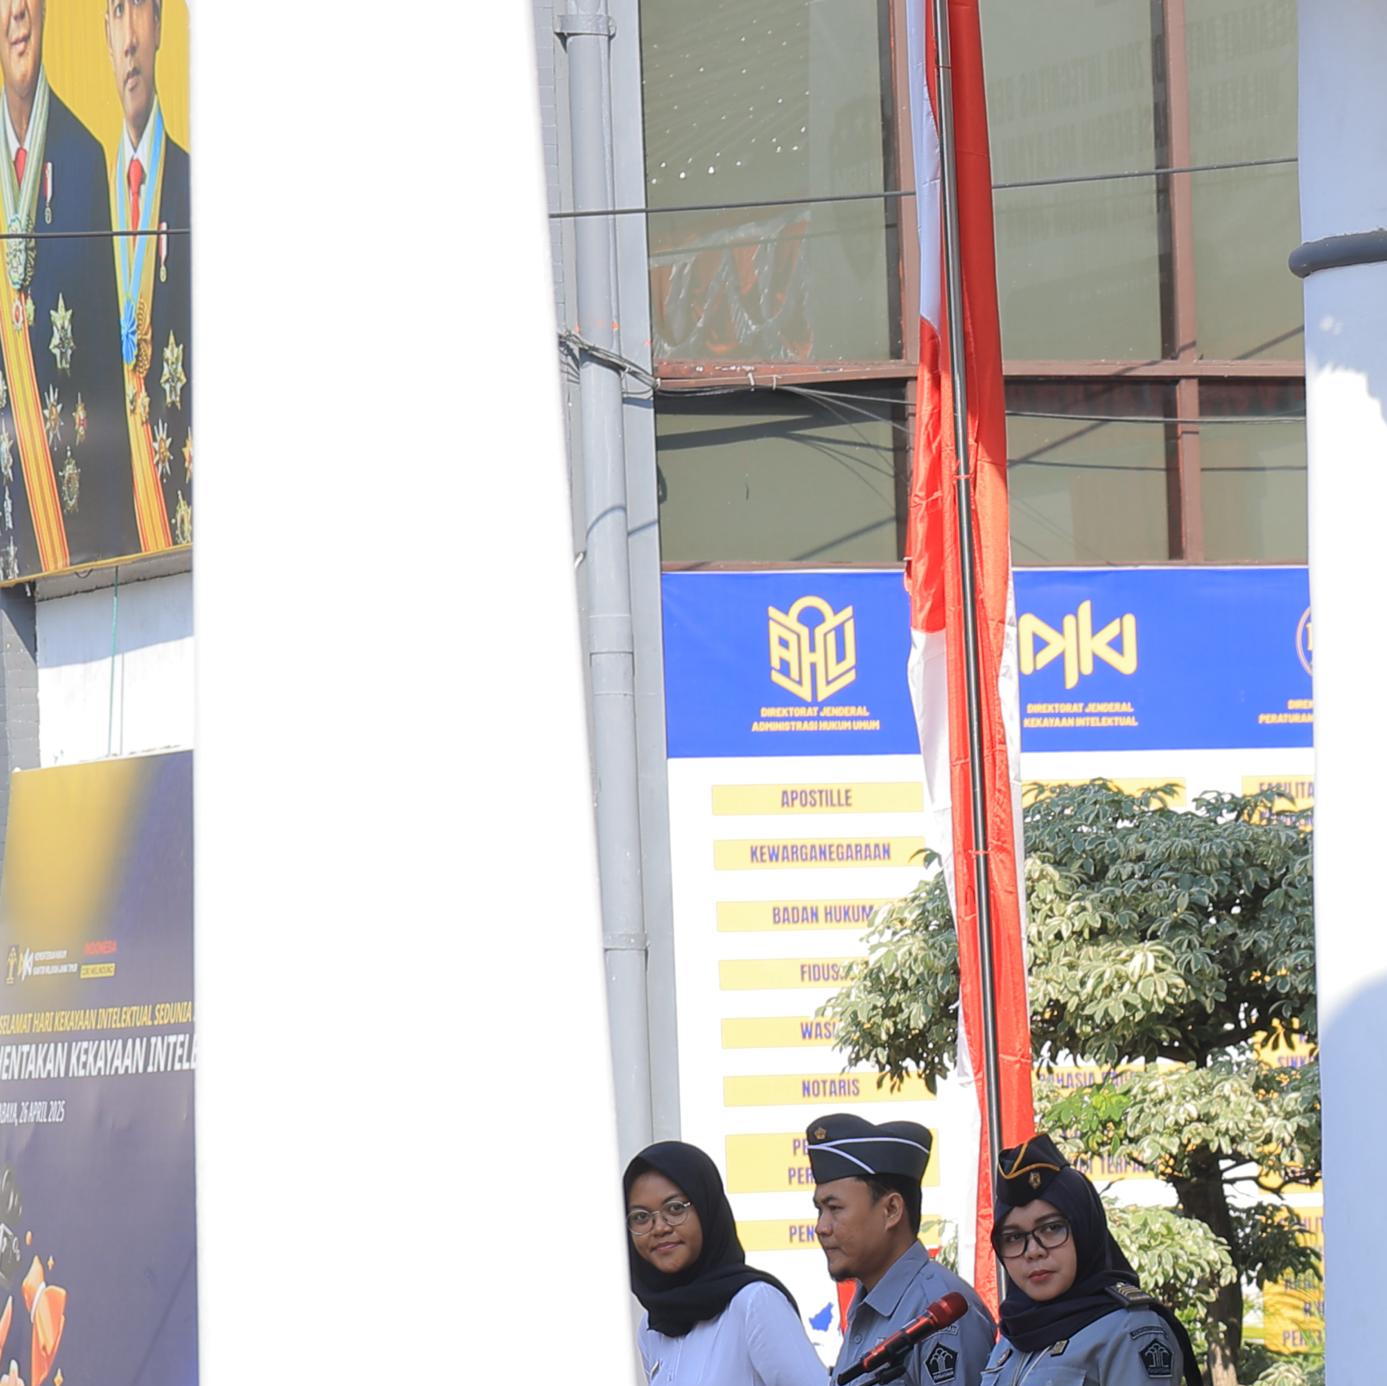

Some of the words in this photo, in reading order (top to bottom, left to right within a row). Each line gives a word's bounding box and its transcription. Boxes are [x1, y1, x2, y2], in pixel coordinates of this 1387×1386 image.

[760, 707, 819, 718] DIREKTORAT
[820, 705, 870, 717] JENDERAL
[1026, 702, 1085, 714] DIREKTORAT
[1085, 701, 1135, 713] JENDERAL
[819, 720, 852, 731] HUKUM
[781, 789, 852, 808] APOSTILLE
[750, 843, 891, 864] KEWARGANEGARAAN
[772, 906, 819, 925] BADAN
[824, 905, 874, 924] HUKUM
[0, 1013, 33, 1035] SELAMAT
[33, 1012, 52, 1032] HARI
[53, 1009, 98, 1031] KEKAYAAN
[98, 1004, 152, 1029] INTELEKTUAL
[154, 1001, 192, 1025] SEDUNIA
[69, 1037, 147, 1077] KEKAYAAN
[802, 1079, 860, 1098] NOTARIS
[29, 1101, 48, 1123] APRIL
[48, 1100, 66, 1122] 2025
